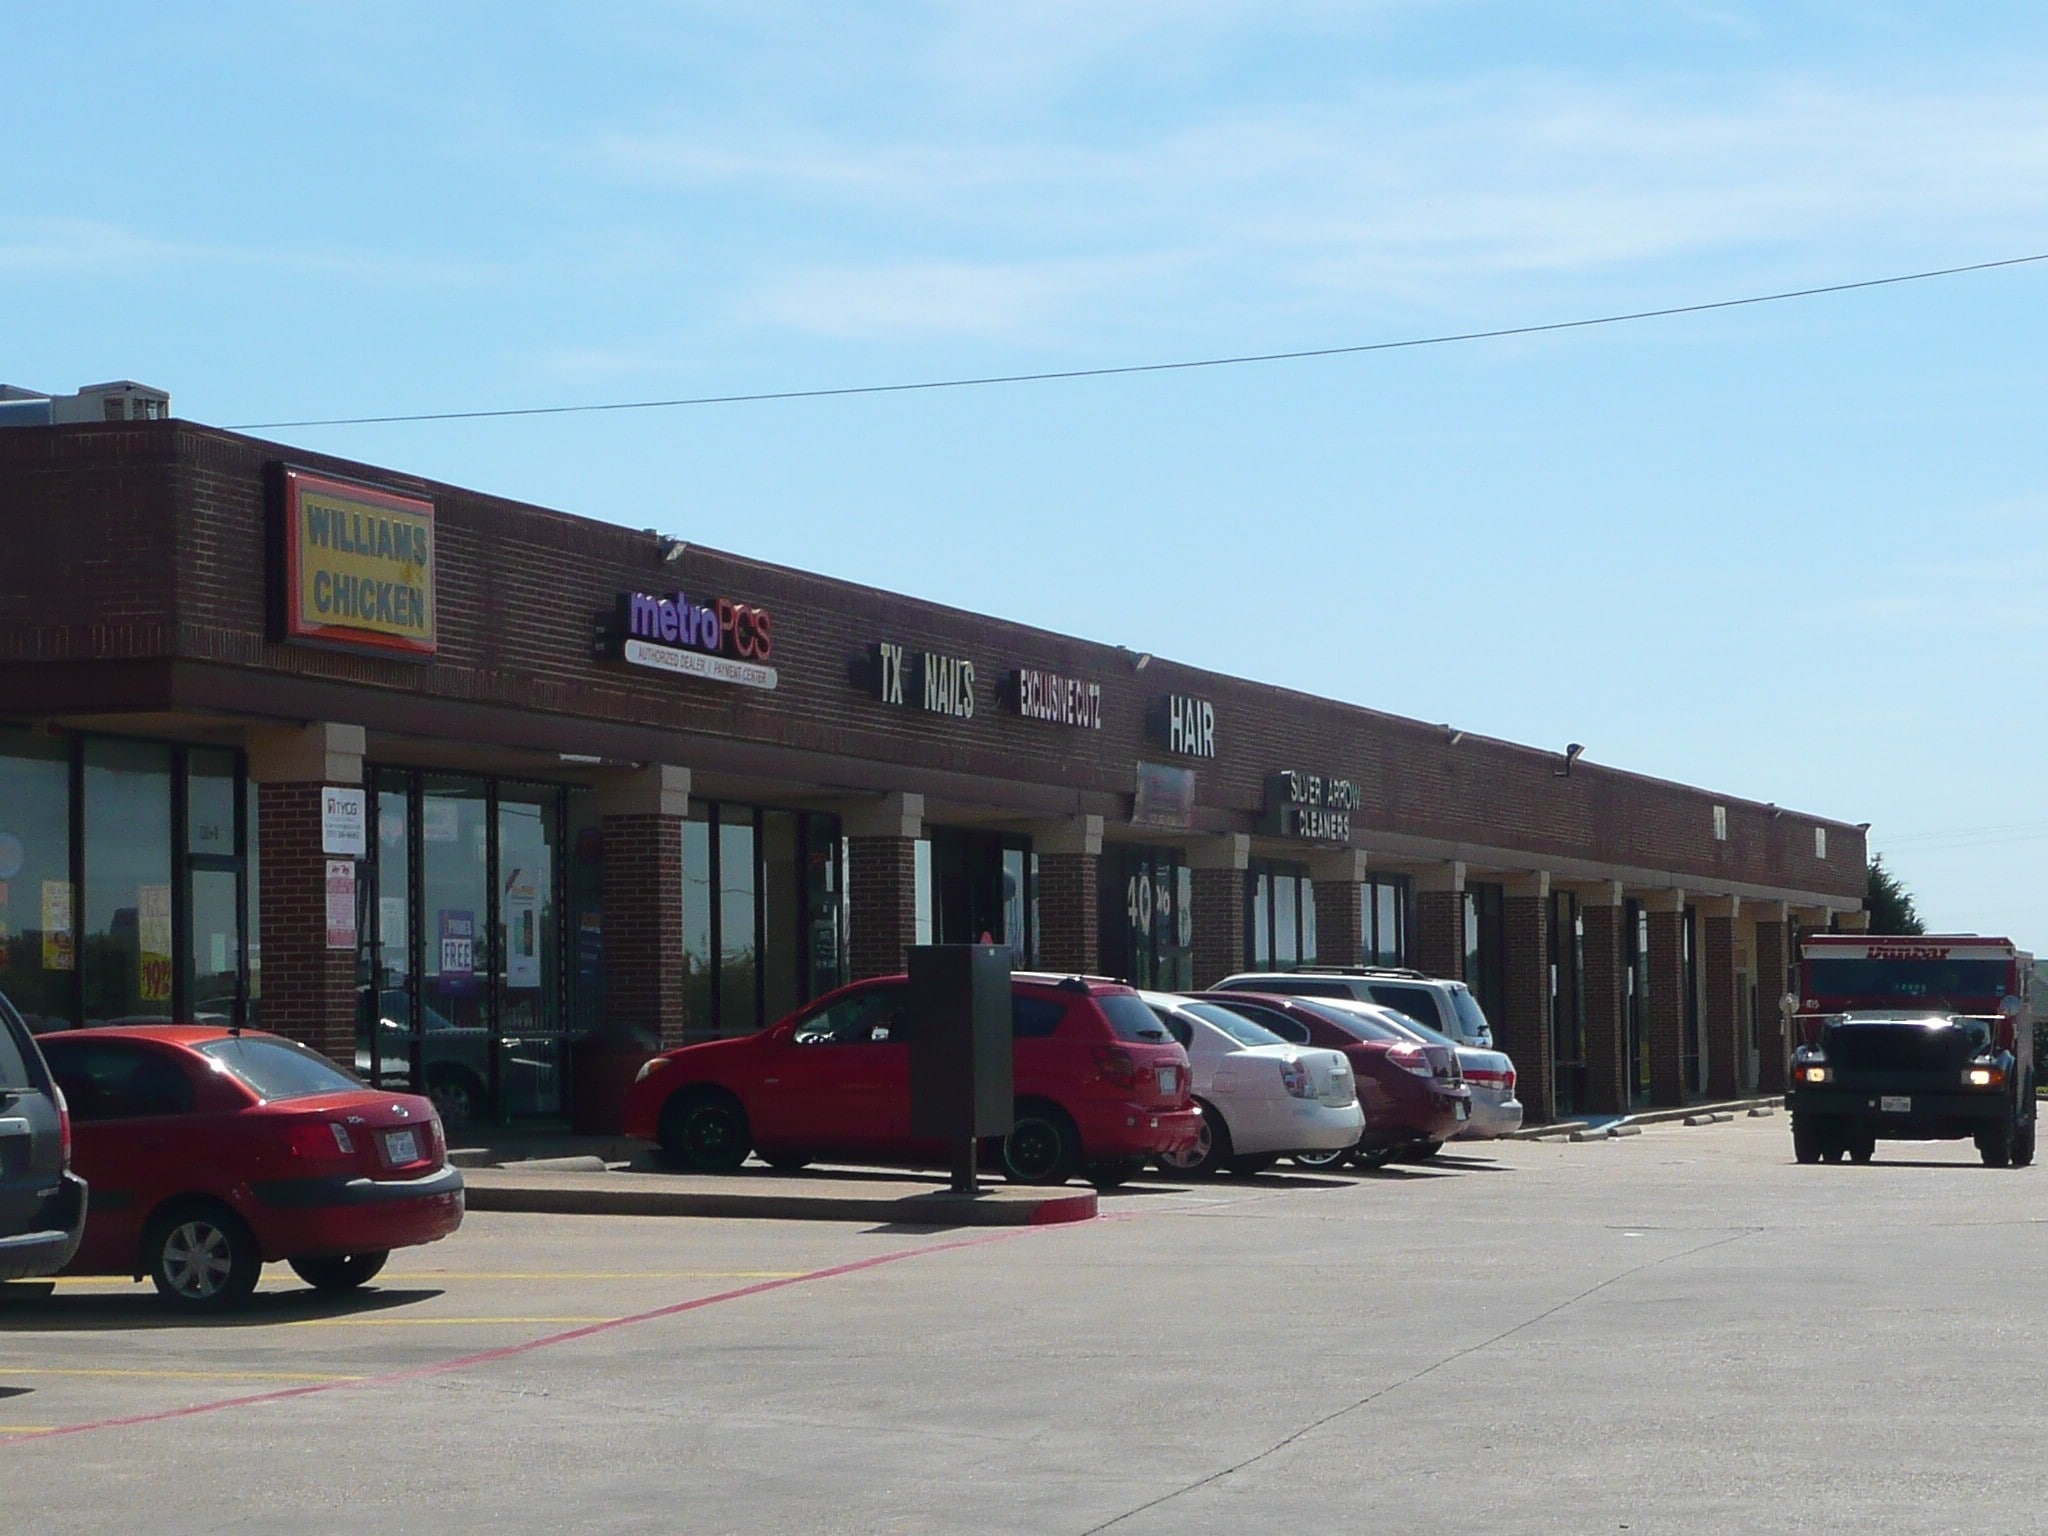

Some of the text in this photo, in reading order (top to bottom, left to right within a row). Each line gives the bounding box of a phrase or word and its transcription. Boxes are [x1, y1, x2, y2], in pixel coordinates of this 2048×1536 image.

[307, 503, 427, 567] WILLIAMS
[313, 569, 424, 629] CHICKEN
[630, 591, 771, 660] metroPCS
[880, 642, 975, 719] TX NAILS
[1020, 669, 1101, 729] EXCLUSIVE CUTZ
[1170, 694, 1215, 758] HAIR
[1299, 809, 1350, 842] CLEANERS
[444, 942, 471, 968] FREE
